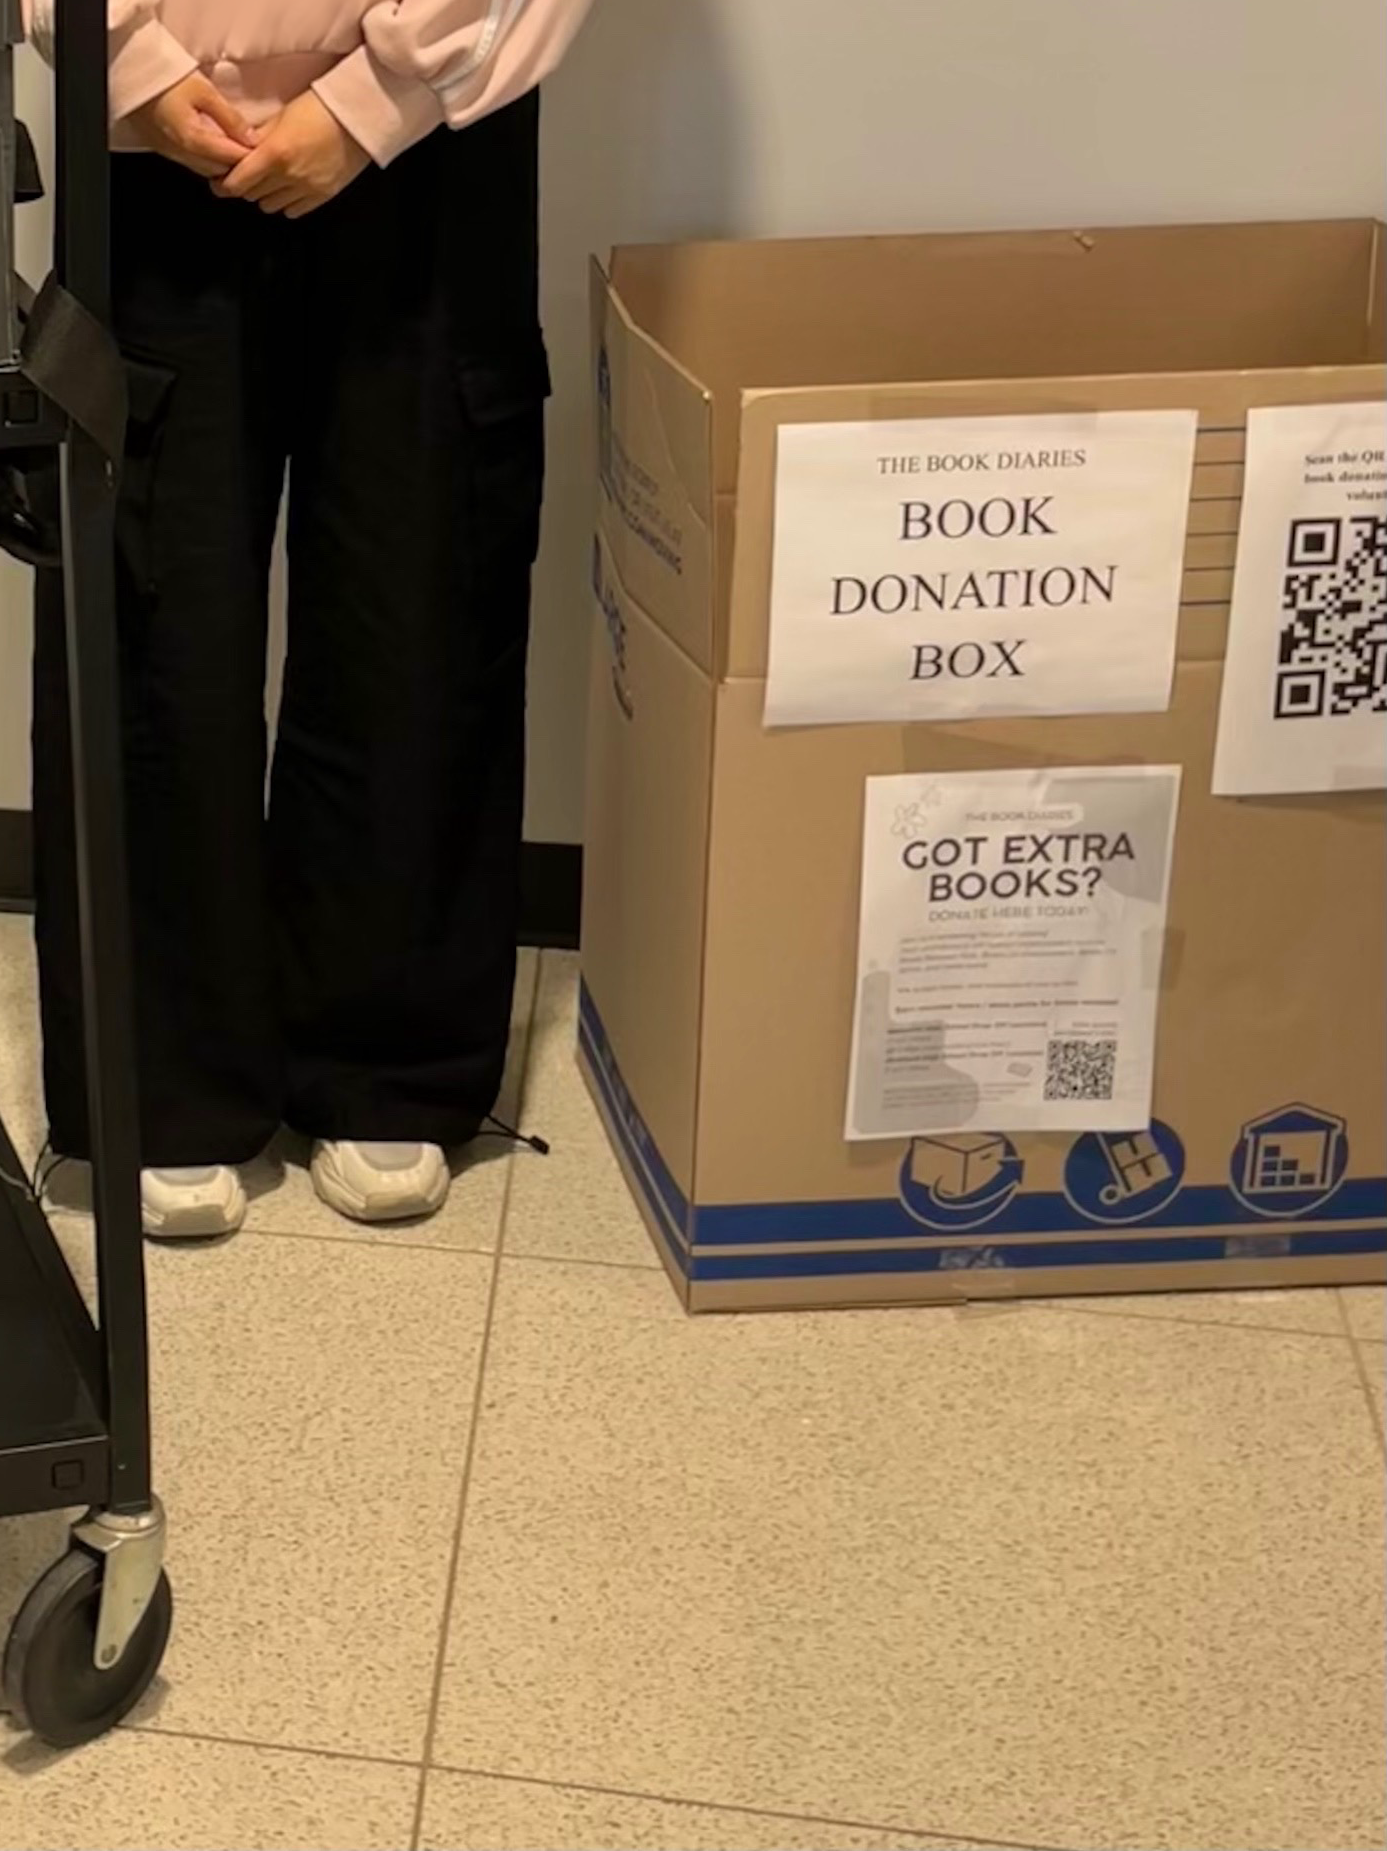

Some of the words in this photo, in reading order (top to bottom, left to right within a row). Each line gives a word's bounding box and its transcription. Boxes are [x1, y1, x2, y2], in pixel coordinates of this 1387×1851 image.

[877, 455, 921, 474] THE
[926, 452, 990, 473] BOOK
[997, 449, 1087, 470] DIARIES
[898, 495, 1057, 541] BOOK
[829, 564, 1119, 616] DONATION
[910, 638, 1027, 680] BOX
[902, 837, 989, 870] GOT
[1002, 832, 1136, 864] EXTRA
[928, 866, 1103, 902] BOOKS?
